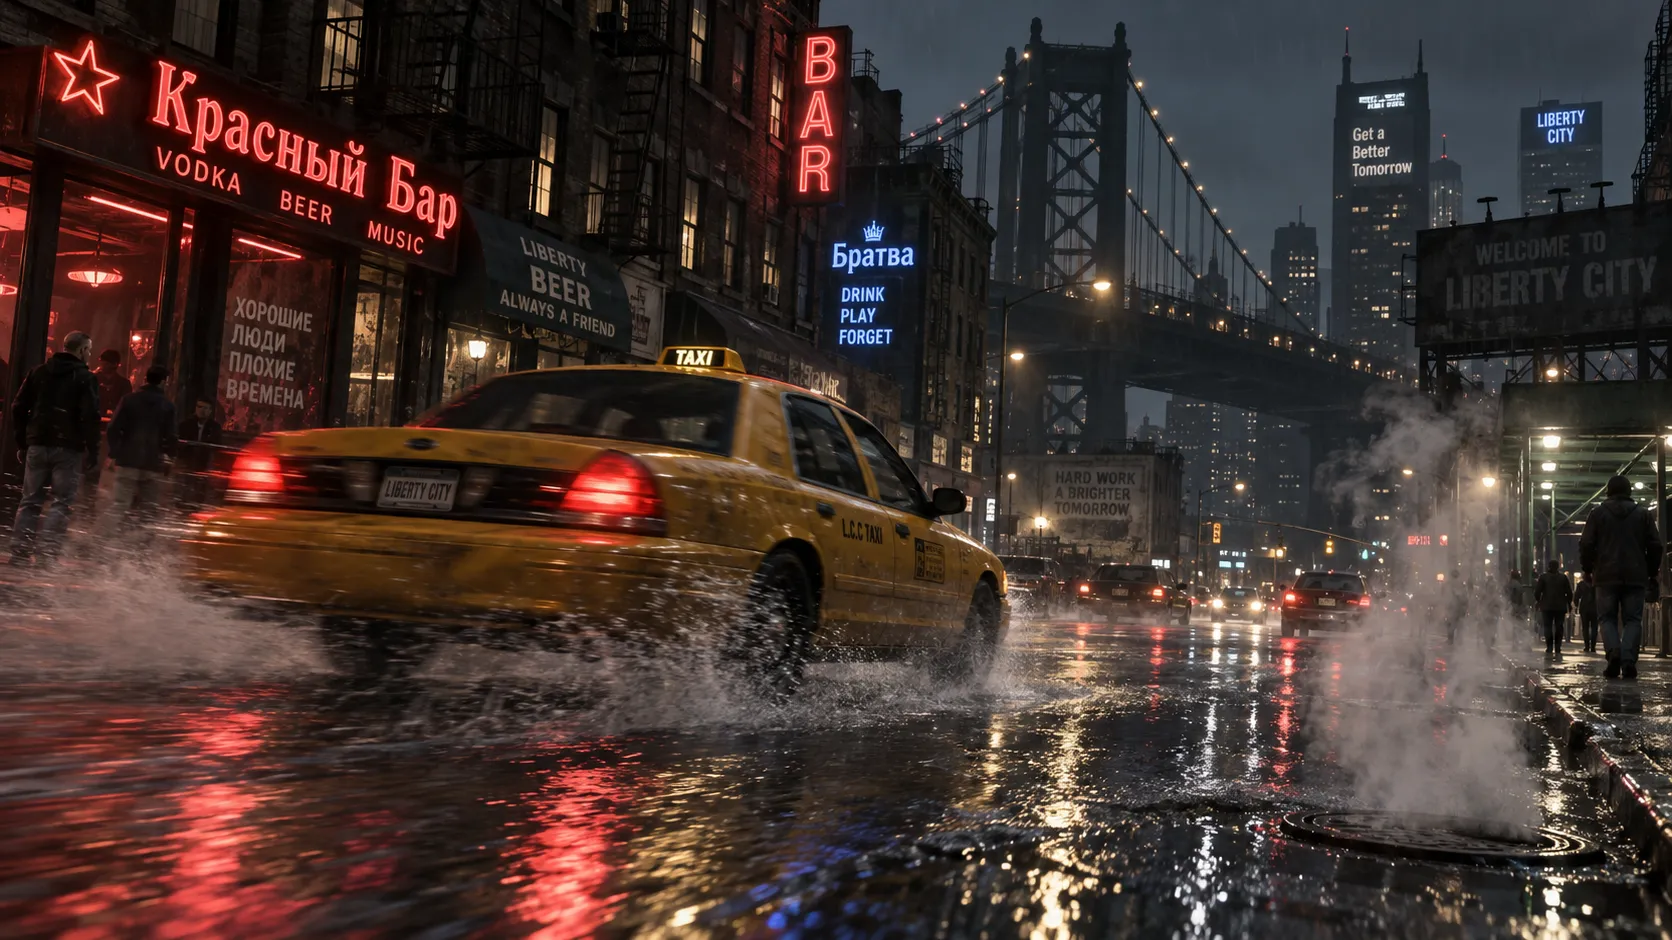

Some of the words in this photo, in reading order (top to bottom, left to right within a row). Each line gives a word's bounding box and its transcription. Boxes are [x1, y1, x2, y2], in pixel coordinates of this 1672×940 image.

[800, 36, 836, 192] BAR
[1537, 109, 1585, 128] LIBERTY
[1352, 127, 1374, 142] Get
[1377, 128, 1385, 140] a
[1547, 127, 1575, 144] CITY
[151, 60, 367, 199] Красный
[386, 155, 457, 239] Бар
[1352, 144, 1390, 160] Better
[1352, 162, 1412, 177] Tomorrow
[156, 146, 241, 196] VODKA
[280, 189, 333, 225] BEER
[368, 220, 424, 255] MUSIC
[520, 236, 587, 277] LIBERTY
[832, 243, 914, 274] Братва
[1475, 234, 1570, 266] WELCOME
[1580, 230, 1606, 254] TO
[530, 264, 592, 310] BEER
[841, 286, 885, 303] DRINK
[1446, 265, 1570, 312] LIBERTY
[1582, 256, 1657, 299] CITY
[234, 296, 313, 333] ХОРОШИЕ
[500, 289, 555, 320] ALWAYS
[559, 308, 568, 325] A
[573, 312, 616, 338] FRIEND
[840, 308, 876, 324] PLAY
[231, 323, 287, 354] ЛЮДИ
[839, 329, 893, 345] FORGET
[228, 351, 296, 382] ПЛОХИЕ
[676, 350, 714, 366] TAXI
[226, 378, 304, 410] ВРЕМЕНА
[385, 480, 428, 500] LIBERTY
[428, 482, 452, 502] CITY
[1055, 470, 1092, 485] HARD
[1096, 471, 1136, 485] WORK
[1055, 486, 1064, 500] A
[1068, 487, 1131, 501] BRIGHTER
[1055, 501, 1131, 517] TOMORROW
[842, 518, 863, 541] L.C.C
[865, 523, 883, 545] TAXI
